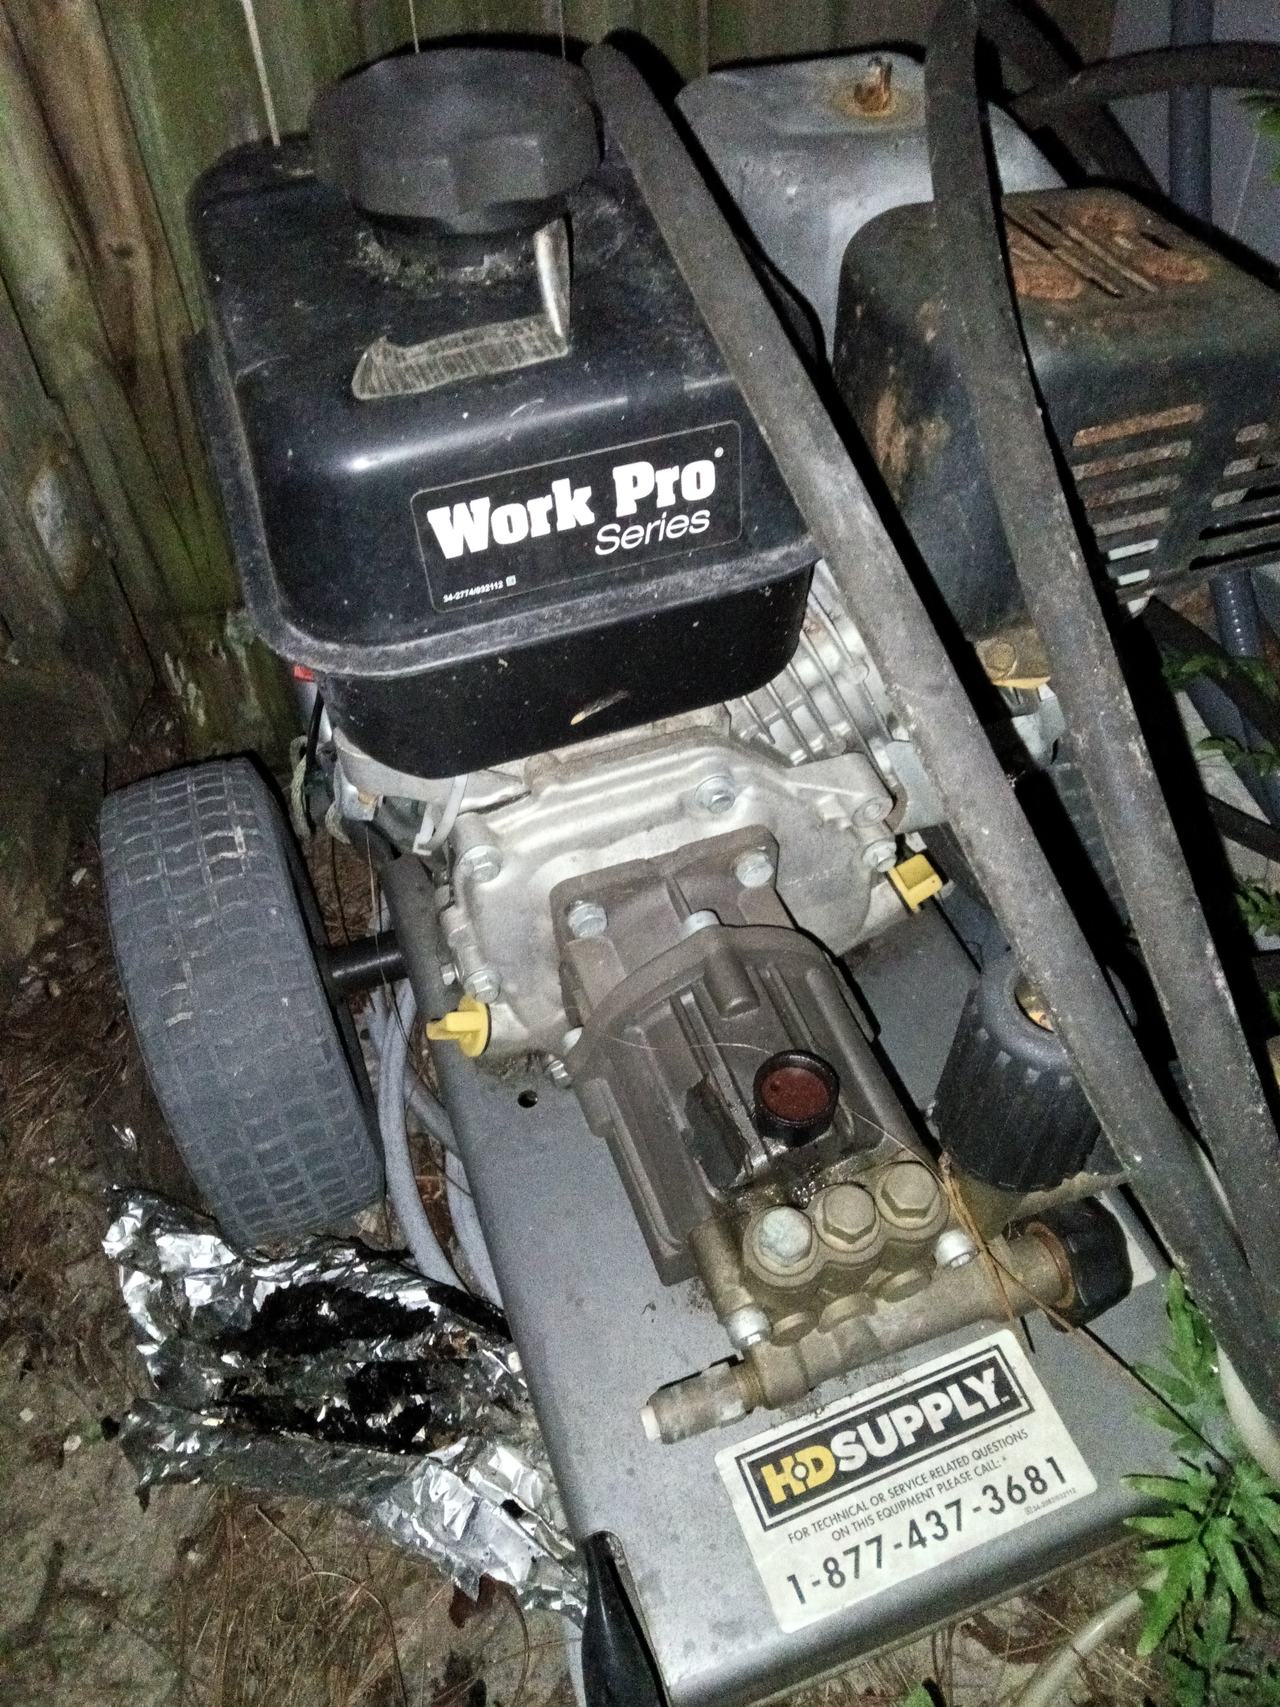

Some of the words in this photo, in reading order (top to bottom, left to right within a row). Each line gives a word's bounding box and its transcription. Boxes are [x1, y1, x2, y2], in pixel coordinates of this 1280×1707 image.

[426, 478, 595, 560] Work
[612, 459, 716, 518] Pro
[595, 509, 711, 556] Series
[786, 1456, 1066, 1605] 1-877-437-3681
[788, 1527, 810, 1543] FOR
[811, 1501, 869, 1534] TECHNICAL
[870, 1493, 886, 1506] OR
[887, 1473, 929, 1499] SERVICE
[929, 1455, 970, 1480] RELATED
[971, 1429, 1029, 1461] QUESTIONS
[831, 1525, 850, 1541] ON
[851, 1514, 875, 1532] THIS
[876, 1487, 935, 1521] EQUIPMENT
[936, 1471, 973, 1494] PLEASE
